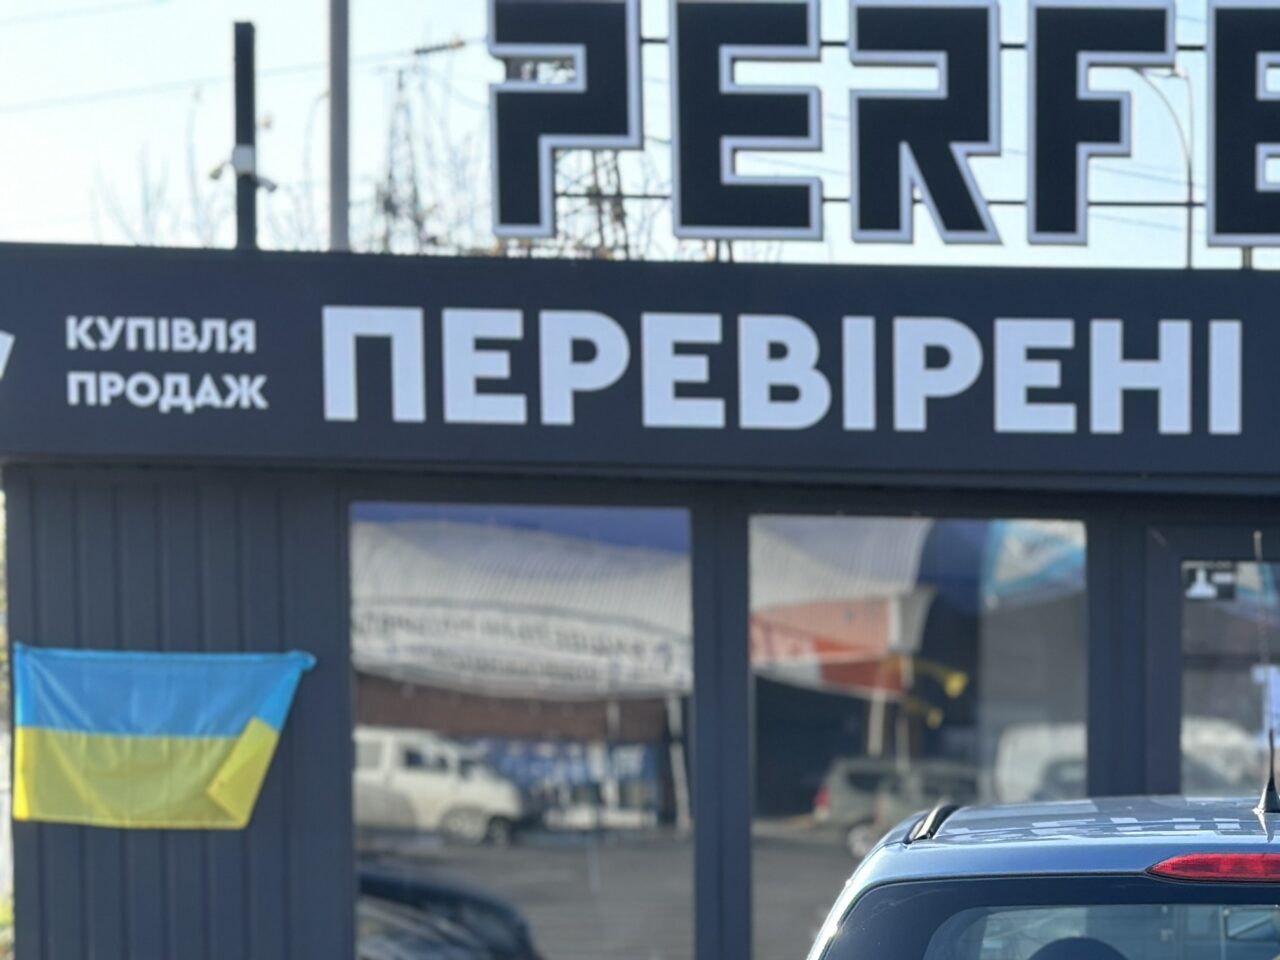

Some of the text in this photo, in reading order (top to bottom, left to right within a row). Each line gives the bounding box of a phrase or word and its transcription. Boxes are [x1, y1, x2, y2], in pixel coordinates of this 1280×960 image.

[65, 316, 256, 353] КУПІВЛЯ
[321, 305, 1243, 435] ПЕРЕВІРЕНІ
[66, 371, 268, 413] ПРОДАЖ
